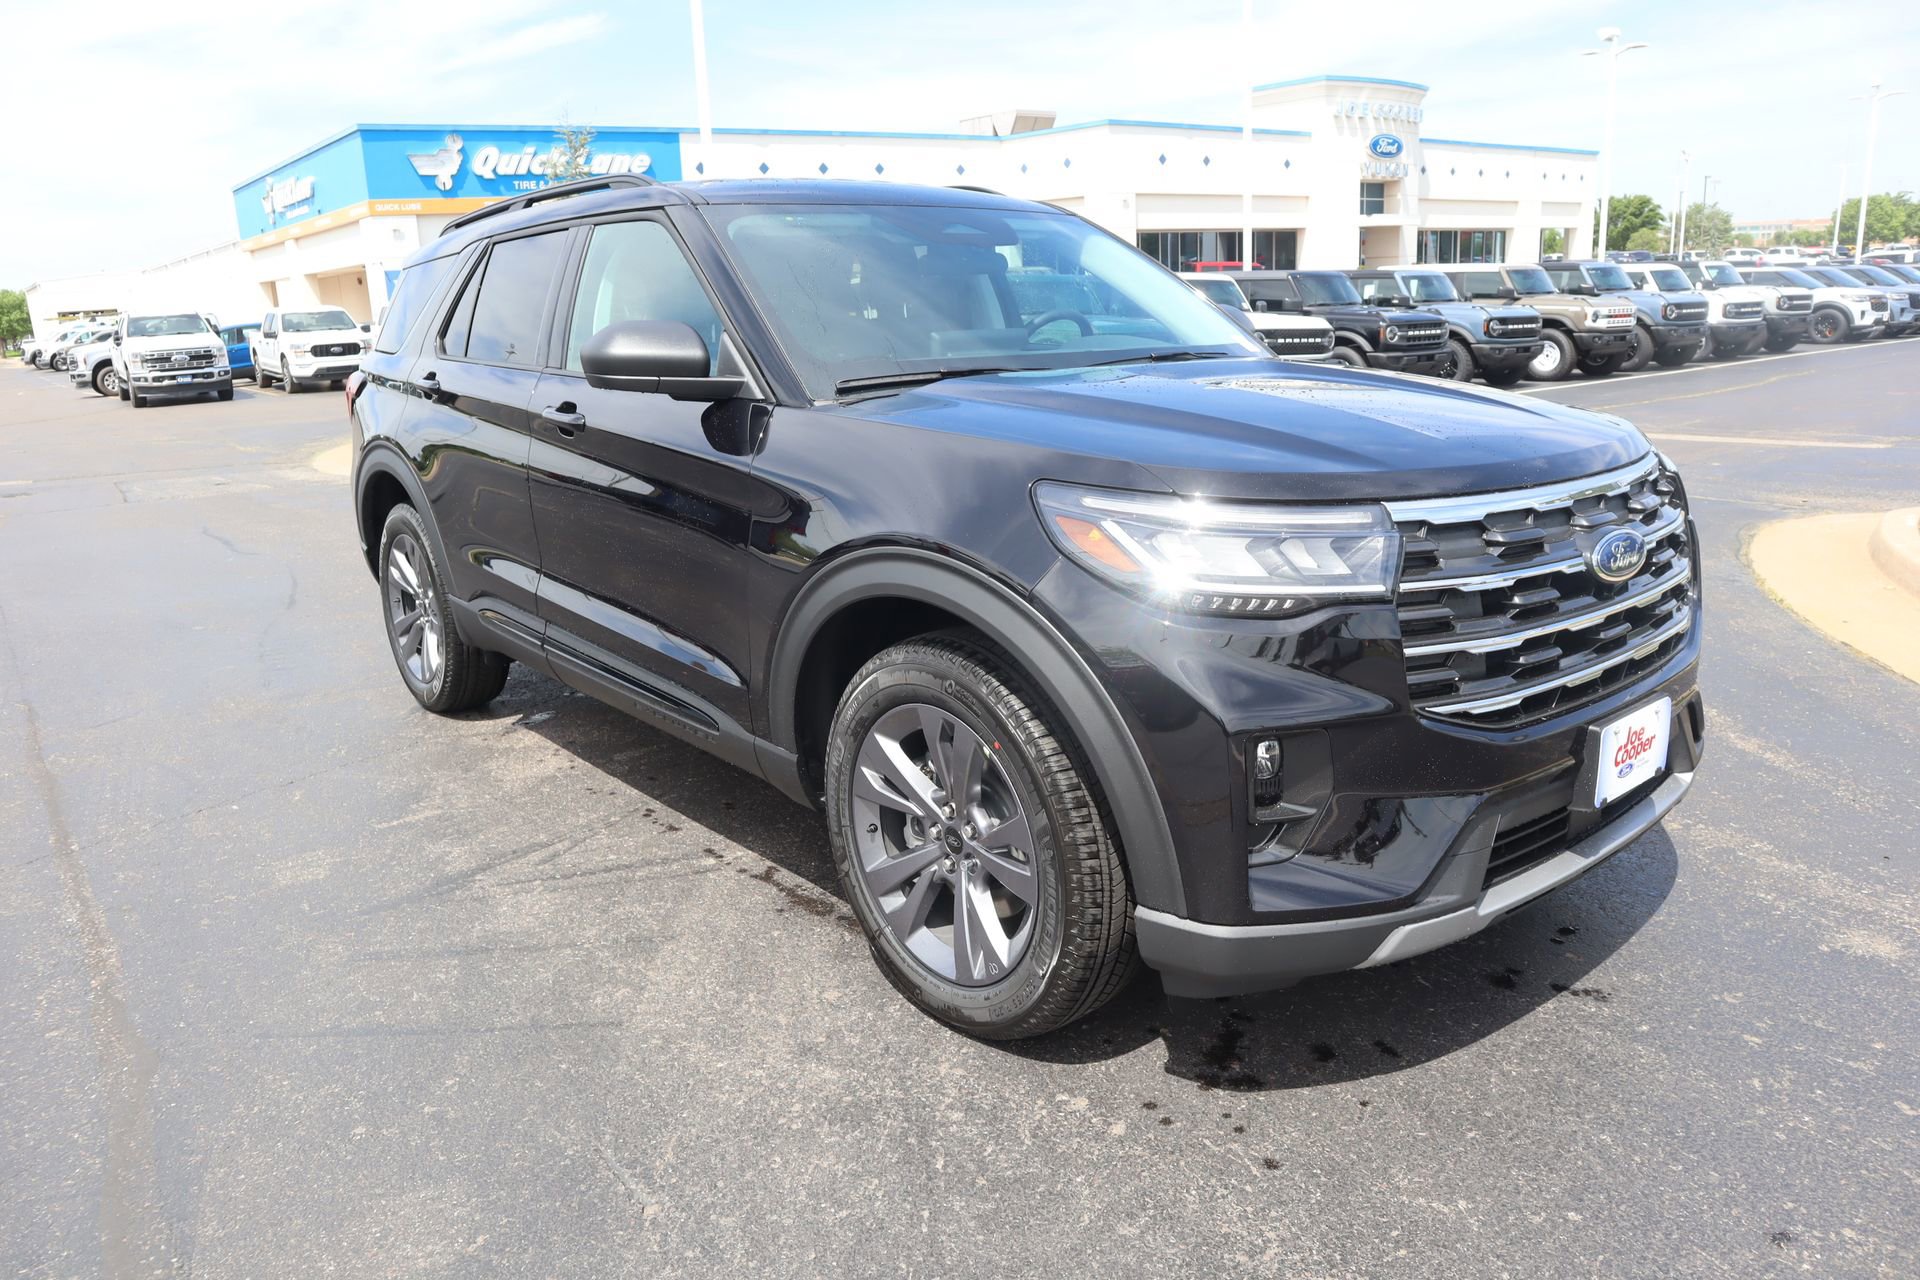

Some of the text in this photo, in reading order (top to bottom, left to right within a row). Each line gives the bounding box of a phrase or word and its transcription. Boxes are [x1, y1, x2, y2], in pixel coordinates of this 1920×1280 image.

[513, 181, 536, 190] TIRE
[1623, 726, 1645, 750] Joe
[1614, 733, 1656, 768] Cooper
